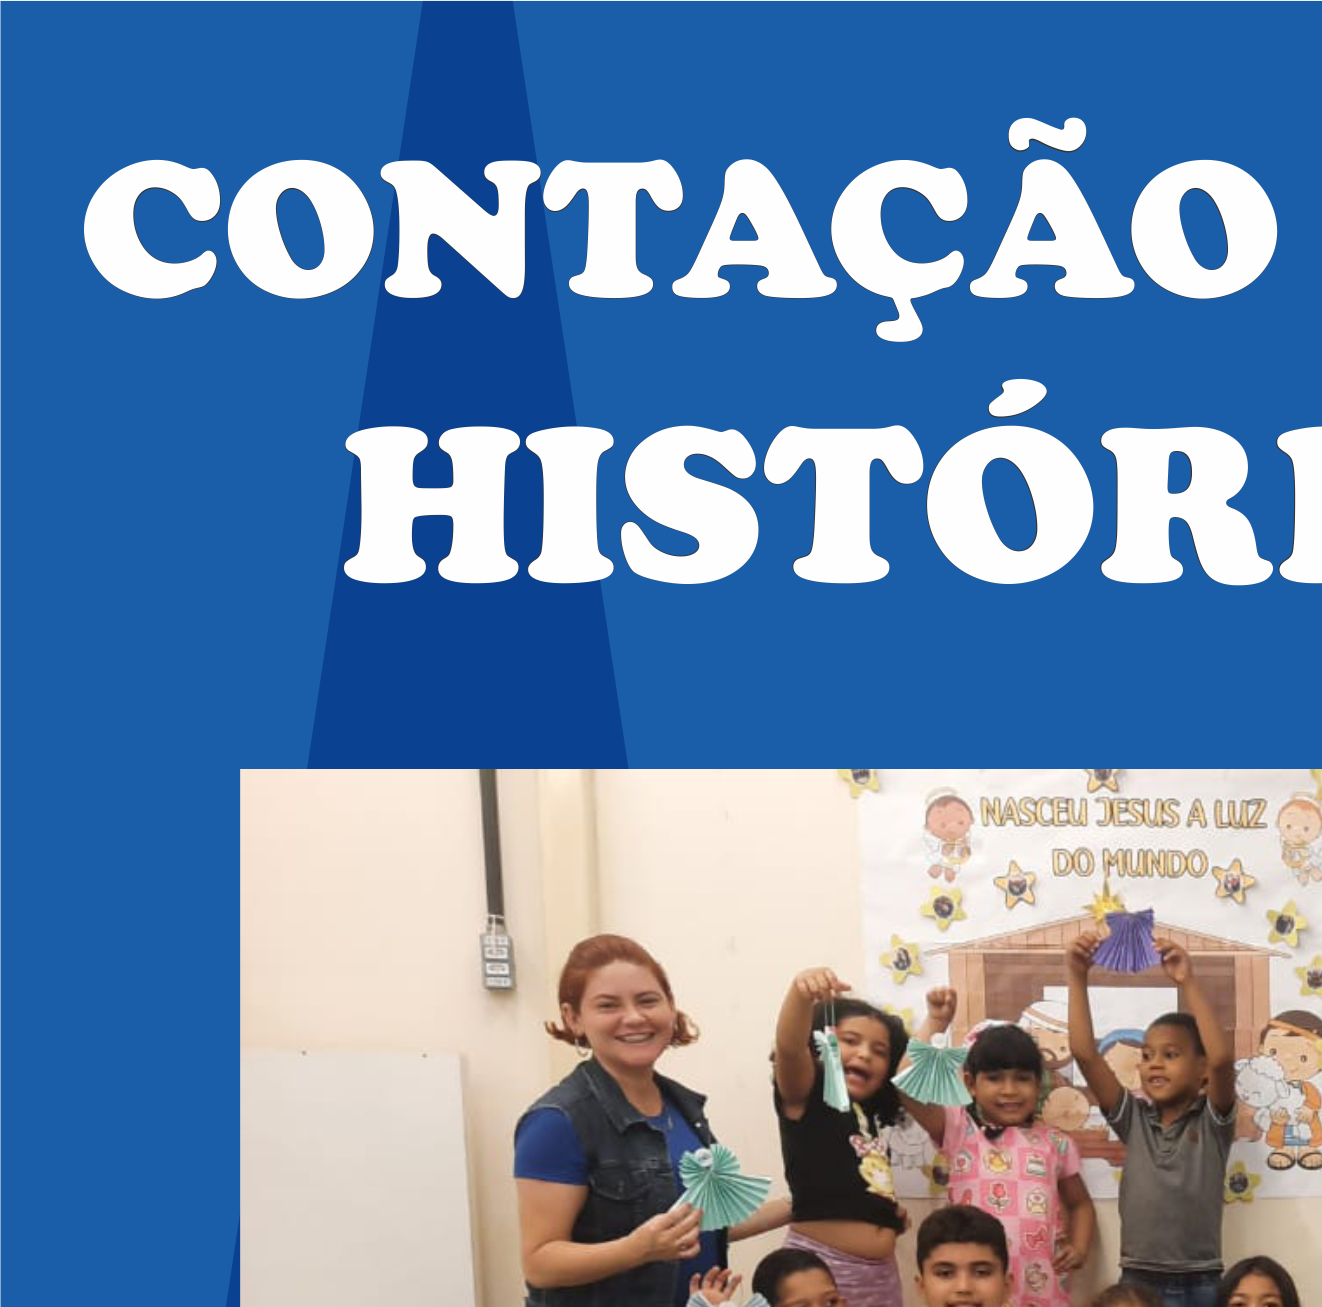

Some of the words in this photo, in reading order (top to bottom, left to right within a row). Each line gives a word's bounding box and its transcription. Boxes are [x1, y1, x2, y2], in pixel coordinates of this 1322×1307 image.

[980, 797, 1087, 827] NASCEU
[1098, 797, 1180, 828] JESUS
[1186, 800, 1207, 828] A
[1213, 800, 1268, 829] LUZ
[1052, 849, 1094, 878] DO
[1102, 849, 1209, 878] MUNDO
